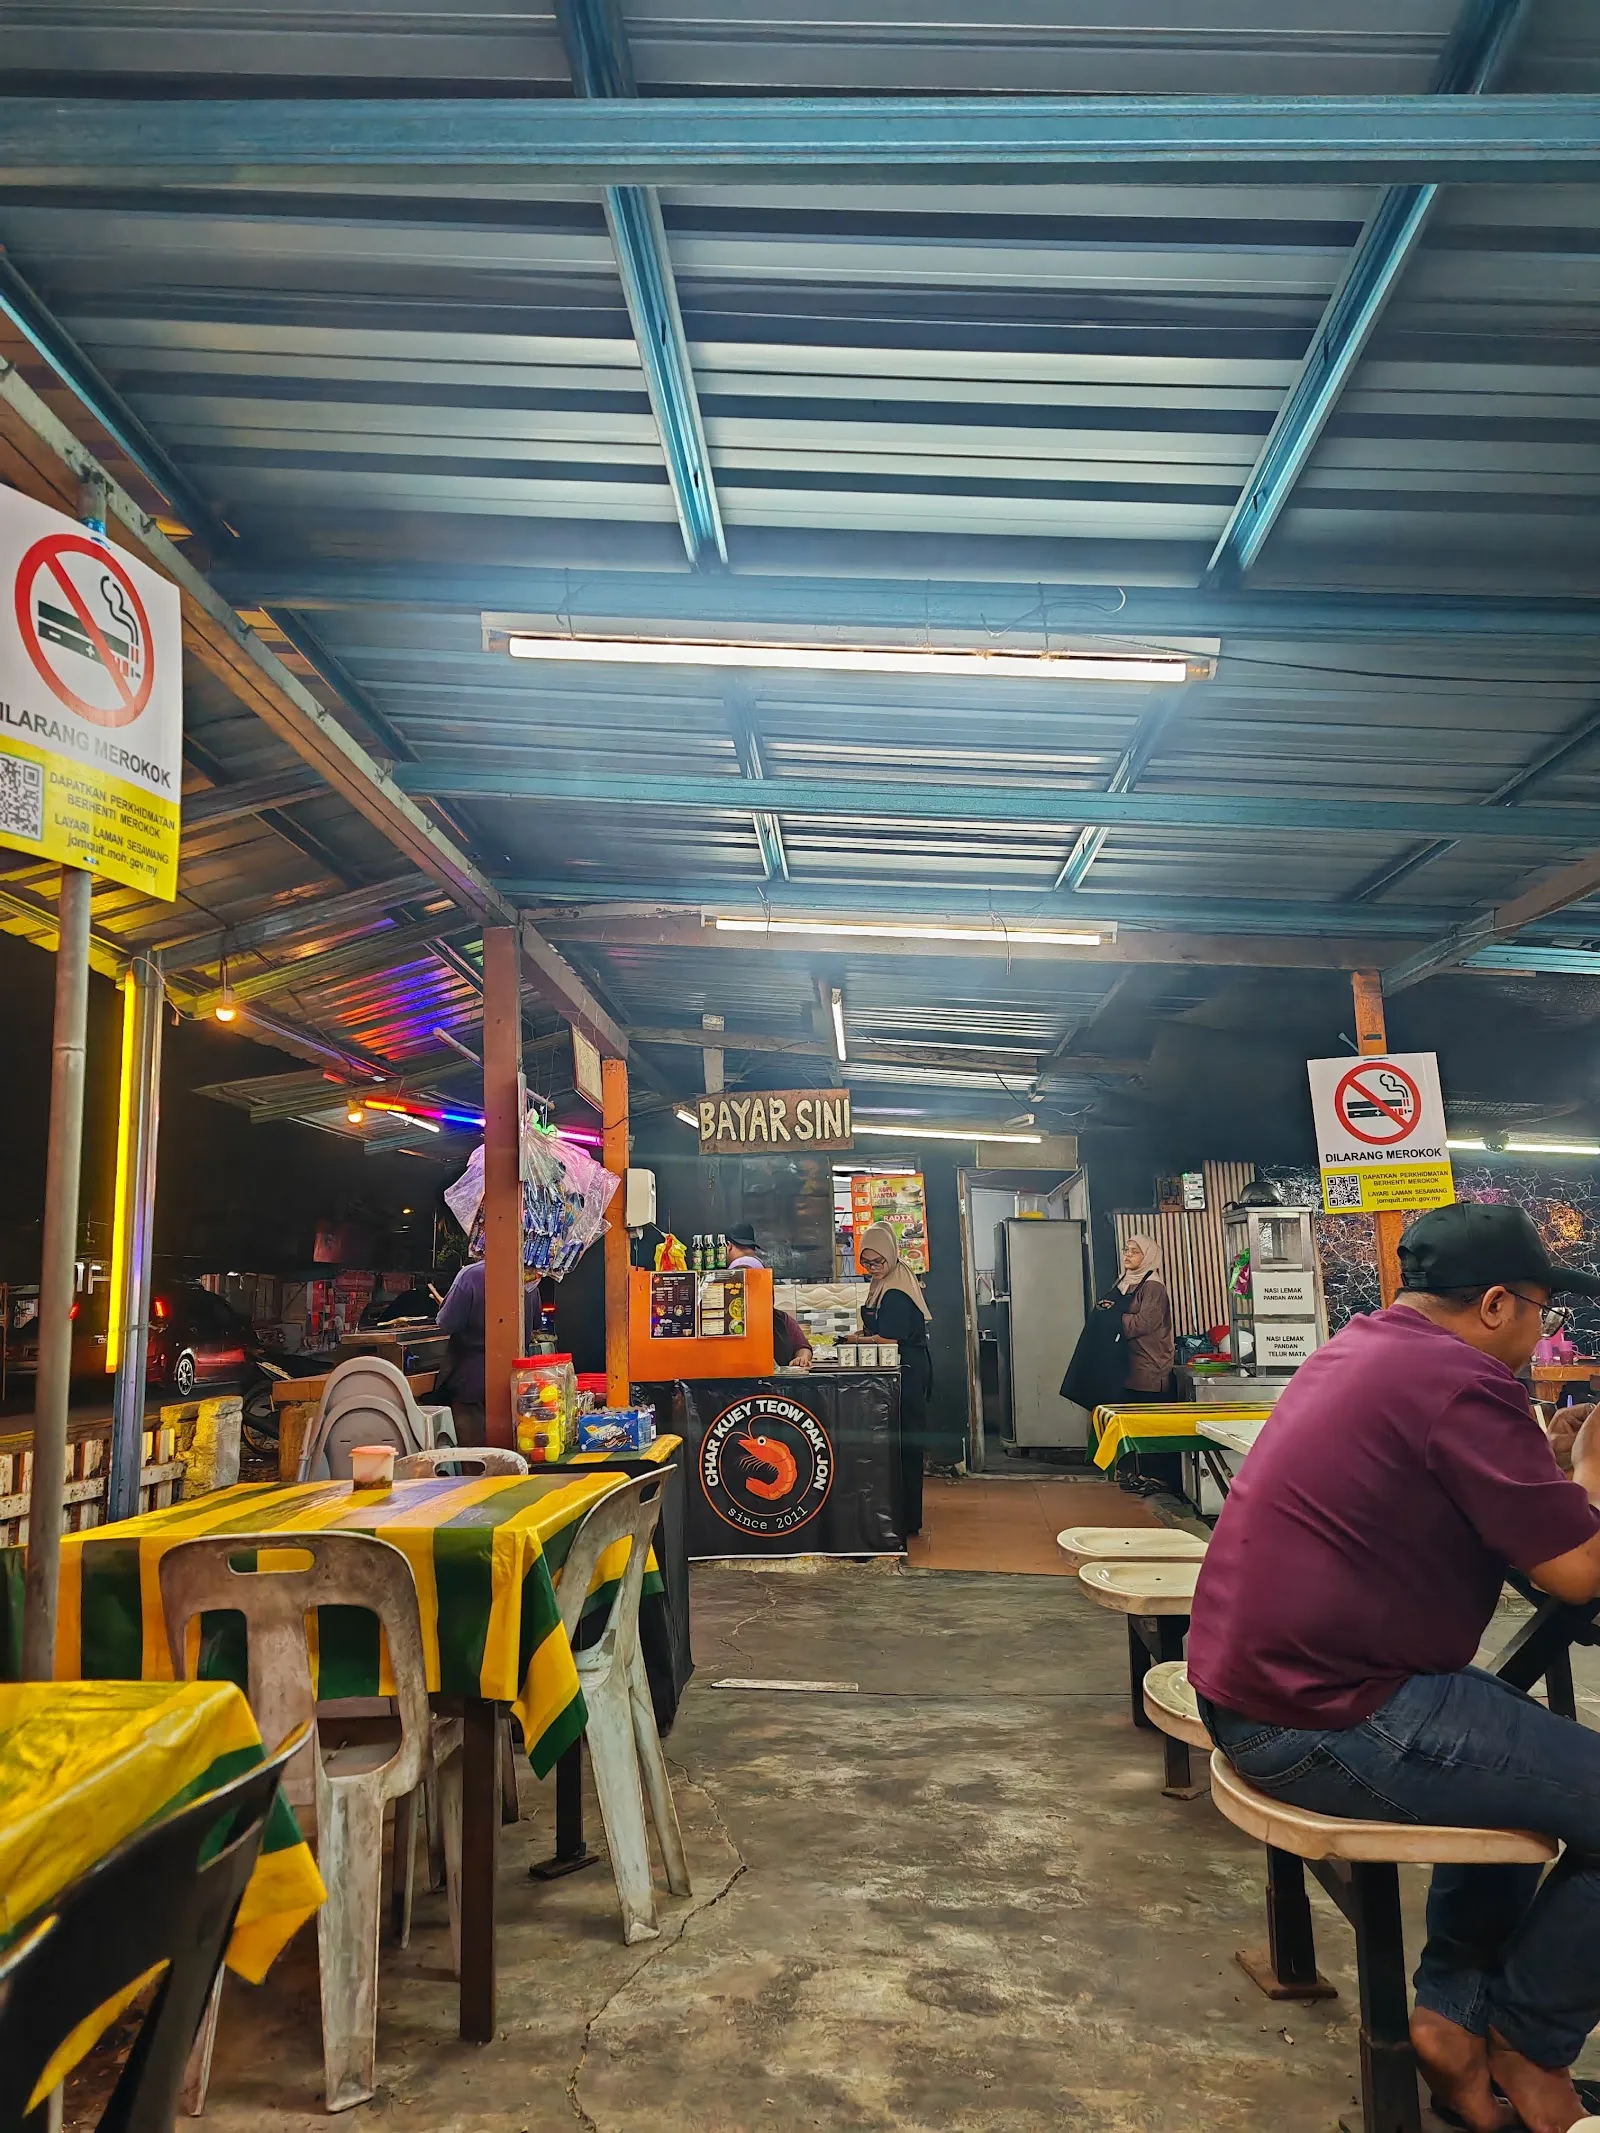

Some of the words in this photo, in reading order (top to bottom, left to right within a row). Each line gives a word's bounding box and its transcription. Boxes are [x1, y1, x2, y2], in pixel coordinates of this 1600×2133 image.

[95, 737, 172, 789] MEROKOK
[50, 772, 107, 802] DAPATKAN
[111, 795, 175, 830] PERKHIDMATAN
[67, 794, 116, 821] BERHENTI
[120, 813, 162, 840] MEROKOK
[55, 813, 90, 835] LAYARI
[93, 826, 124, 846] LAMAN
[127, 840, 169, 864] SESAWANG
[67, 833, 159, 877] jomquit.moh.gov.my
[699, 1097, 792, 1143] BAYAR
[794, 1099, 850, 1141] SINI
[1325, 1151, 1384, 1163] DILARANG
[1386, 1148, 1442, 1160] MEROKOK
[1400, 1170, 1449, 1178] PERKHIDMATAN
[1407, 1177, 1440, 1185] MEROKOK
[1415, 1187, 1448, 1195] SESAWANG
[883, 1214, 912, 1222] RADIX
[1376, 1196, 1441, 1205] jomquit.moh.gov.my
[712, 1402, 752, 1438] KUEY
[756, 1399, 805, 1422] TEOW
[801, 1418, 827, 1452] PAK
[704, 1438, 721, 1487] CHAR
[812, 1454, 829, 1491] JON
[727, 1507, 768, 1530] since
[775, 1505, 808, 1529] 2011
